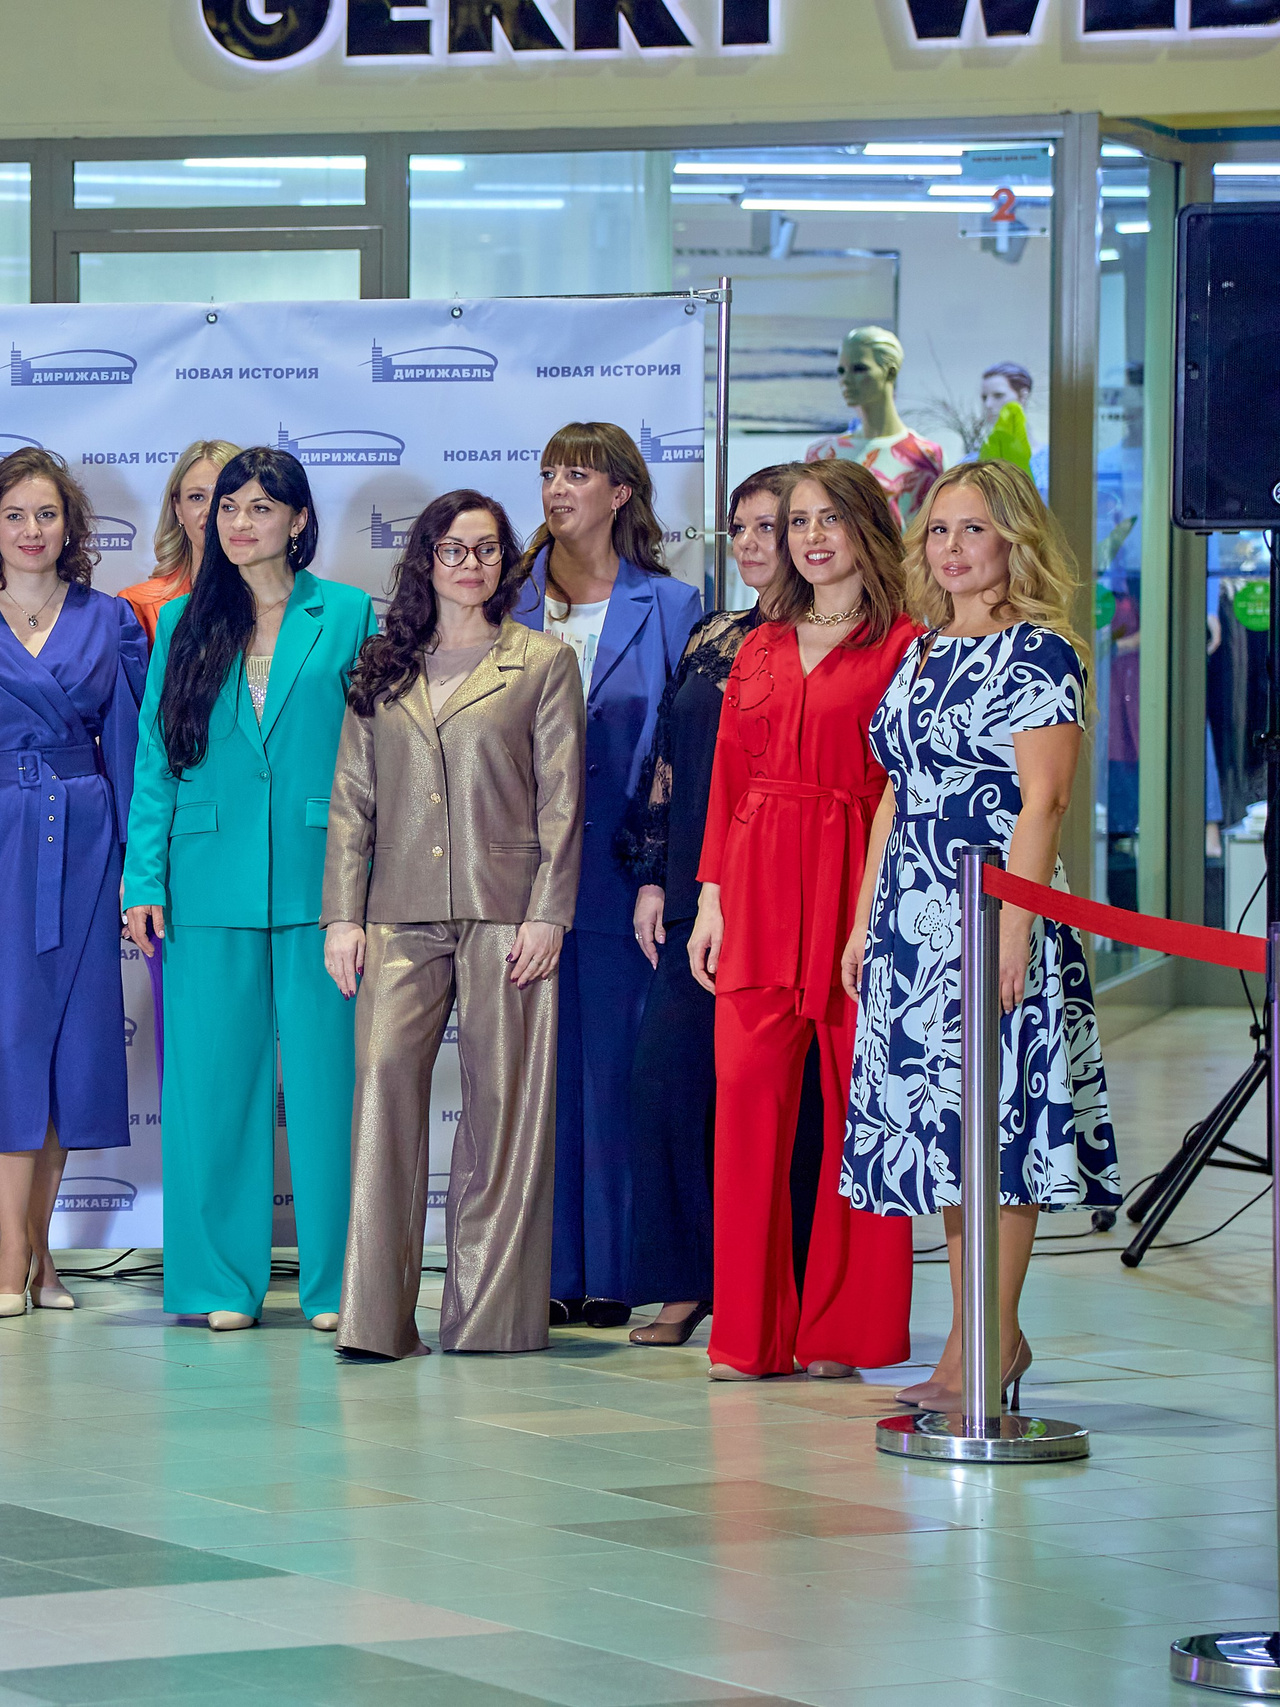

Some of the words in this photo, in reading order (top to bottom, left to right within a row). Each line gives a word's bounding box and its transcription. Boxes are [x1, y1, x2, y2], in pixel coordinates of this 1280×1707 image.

[991, 188, 1016, 222] 2
[32, 370, 130, 384] ДИРИЖАБЛЬ
[175, 368, 233, 380] НОВАЯ
[238, 368, 319, 380] ИСТОРИЯ
[393, 367, 492, 381] ДИРИЖАБЛЬ
[536, 365, 595, 378] НОВАЯ
[600, 364, 681, 377] ИСТОРИЯ
[82, 452, 140, 465] НОВАЯ
[299, 451, 398, 464] ДИРИЖАБЛЬ
[443, 449, 502, 462] НОВАЯ
[55, 1198, 131, 1210] РИЖАБЛЬ
